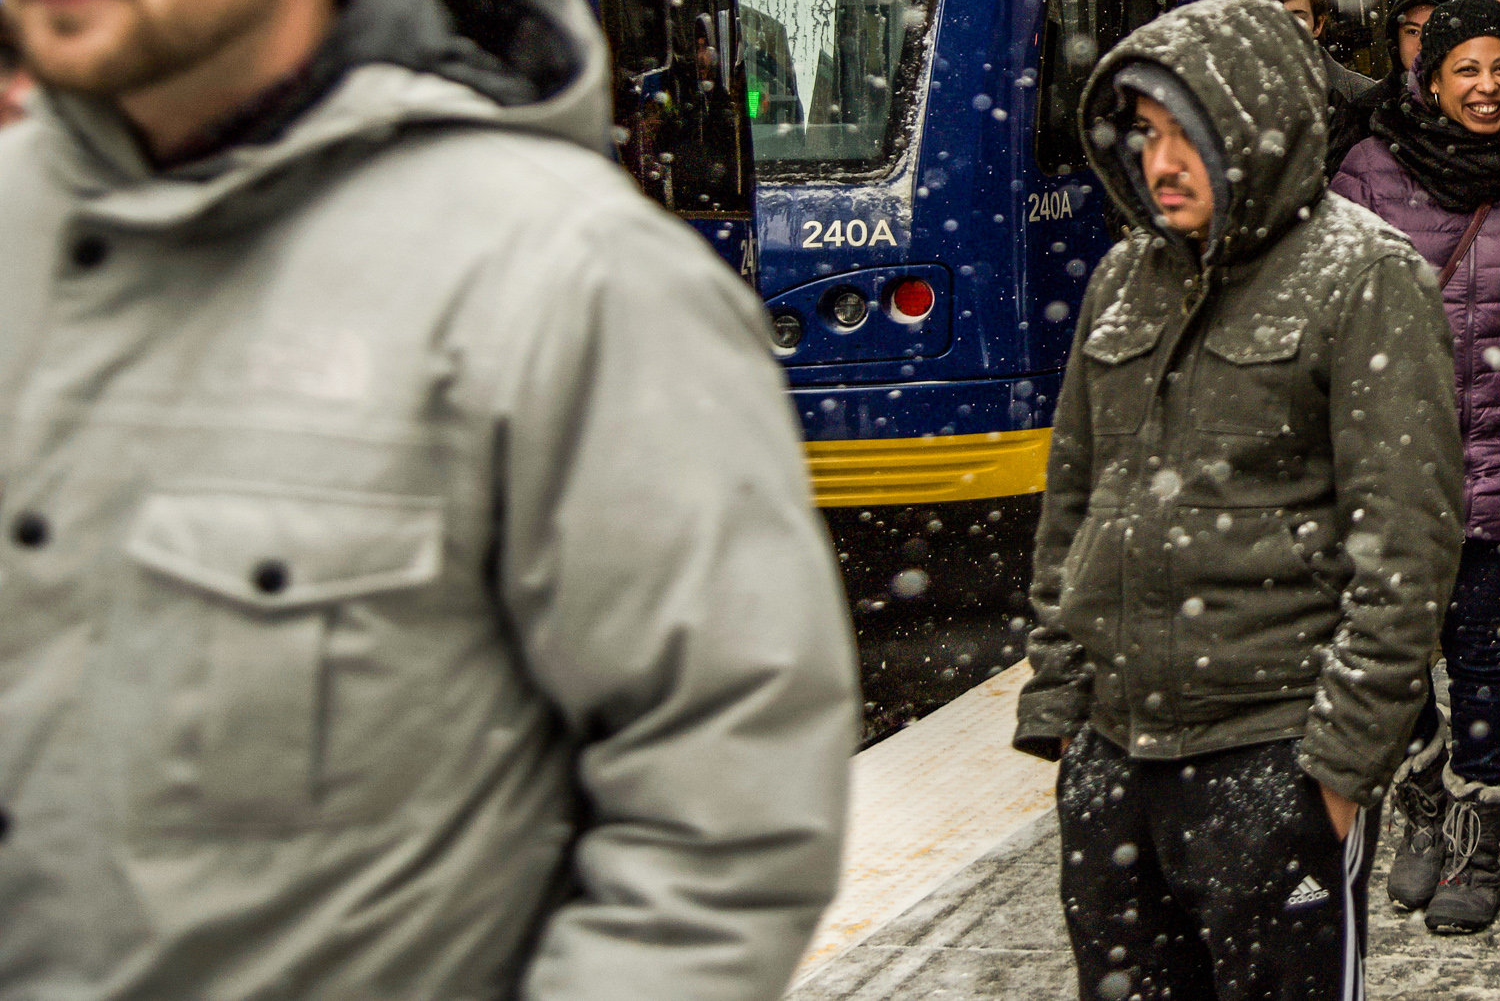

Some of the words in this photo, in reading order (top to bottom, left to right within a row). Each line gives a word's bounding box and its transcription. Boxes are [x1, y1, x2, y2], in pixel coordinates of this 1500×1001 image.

[1028, 190, 1074, 223] 240A
[801, 219, 898, 249] 240A
[1288, 890, 1330, 905] adidas
